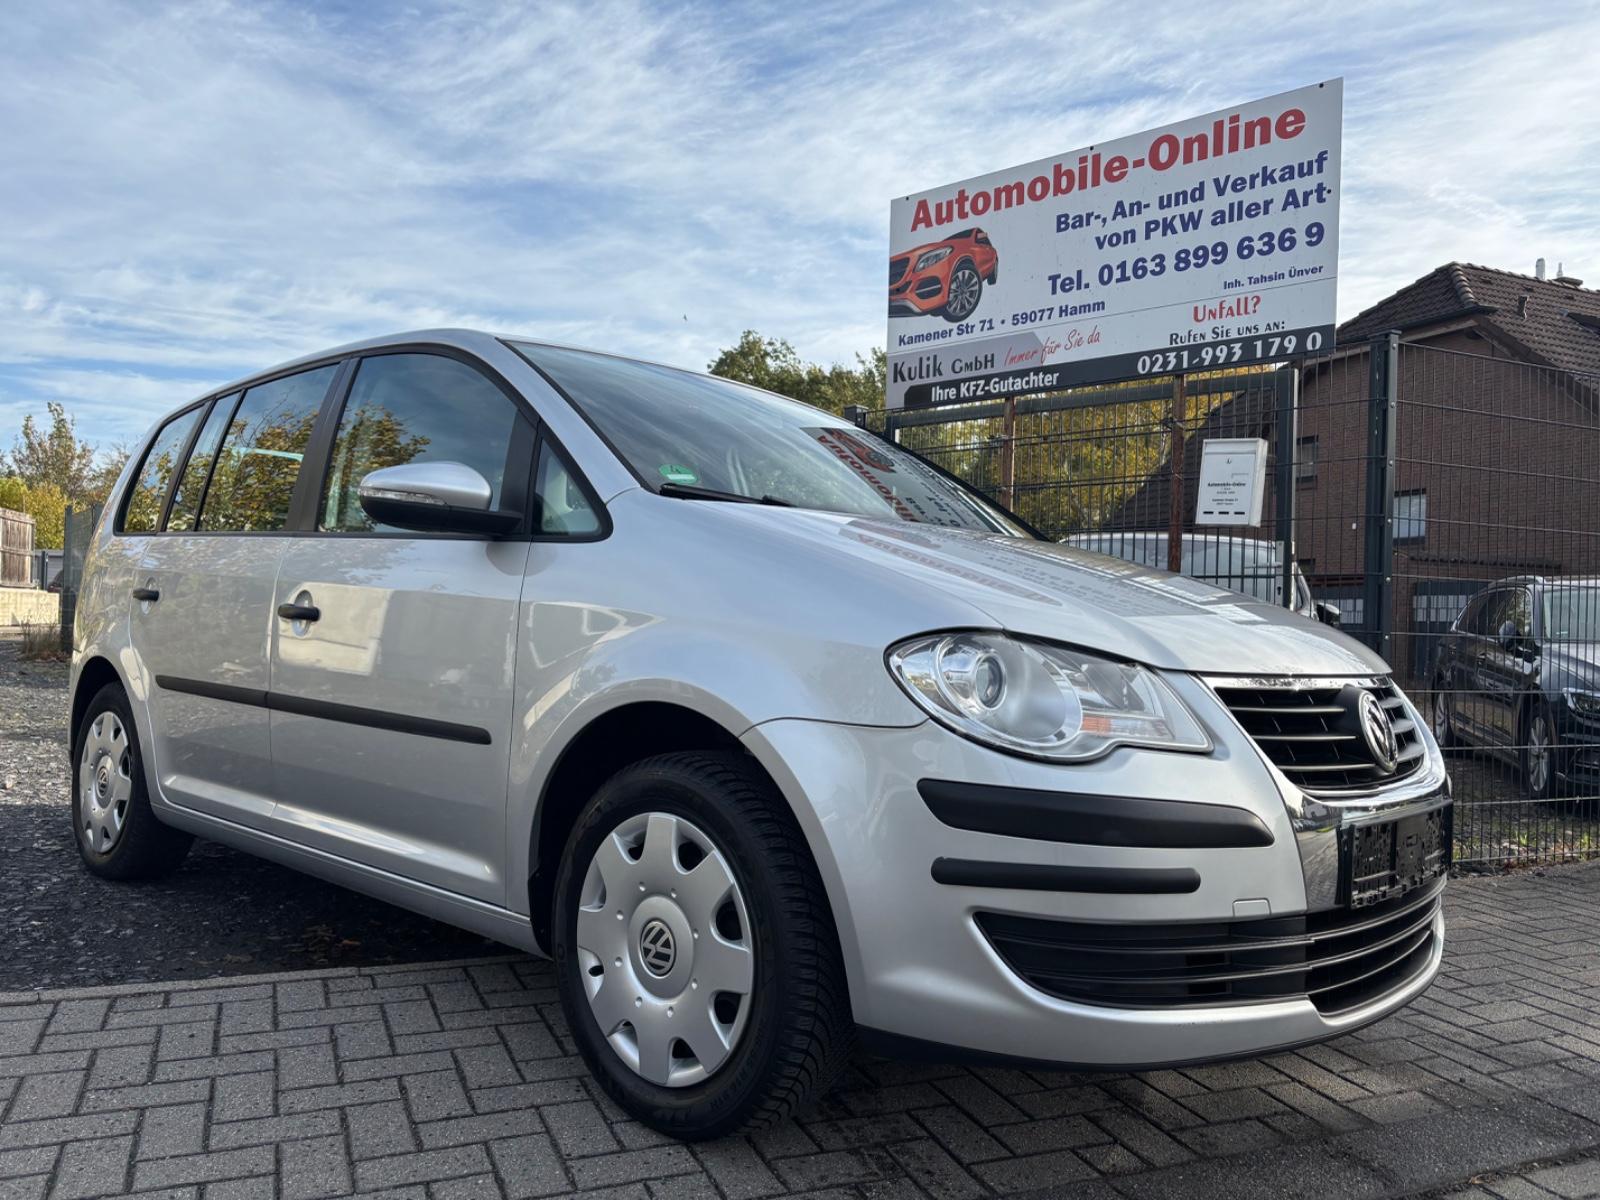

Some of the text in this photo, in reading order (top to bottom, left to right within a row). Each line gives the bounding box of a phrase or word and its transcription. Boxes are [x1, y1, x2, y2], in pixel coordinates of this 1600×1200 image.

[911, 108, 1306, 232] Automobile-Online
[1056, 150, 1328, 233] Bar-, An- und Verkauf
[1095, 228, 1136, 250] von
[1144, 209, 1203, 240] PKW
[1210, 198, 1274, 227] aller
[1048, 222, 1325, 296] Tel. 0163 899 636 9
[1224, 265, 1324, 290] Inh. Tahsin Ünver
[899, 300, 1106, 346] Kamener Str 71 59077 Hamm
[1004, 324, 1100, 367] Immer für Sie da
[892, 354, 943, 384] Kulik
[1137, 331, 1322, 375] 0231-993 179 0
[931, 371, 1060, 402] Ihre KFZ-Gutachter
